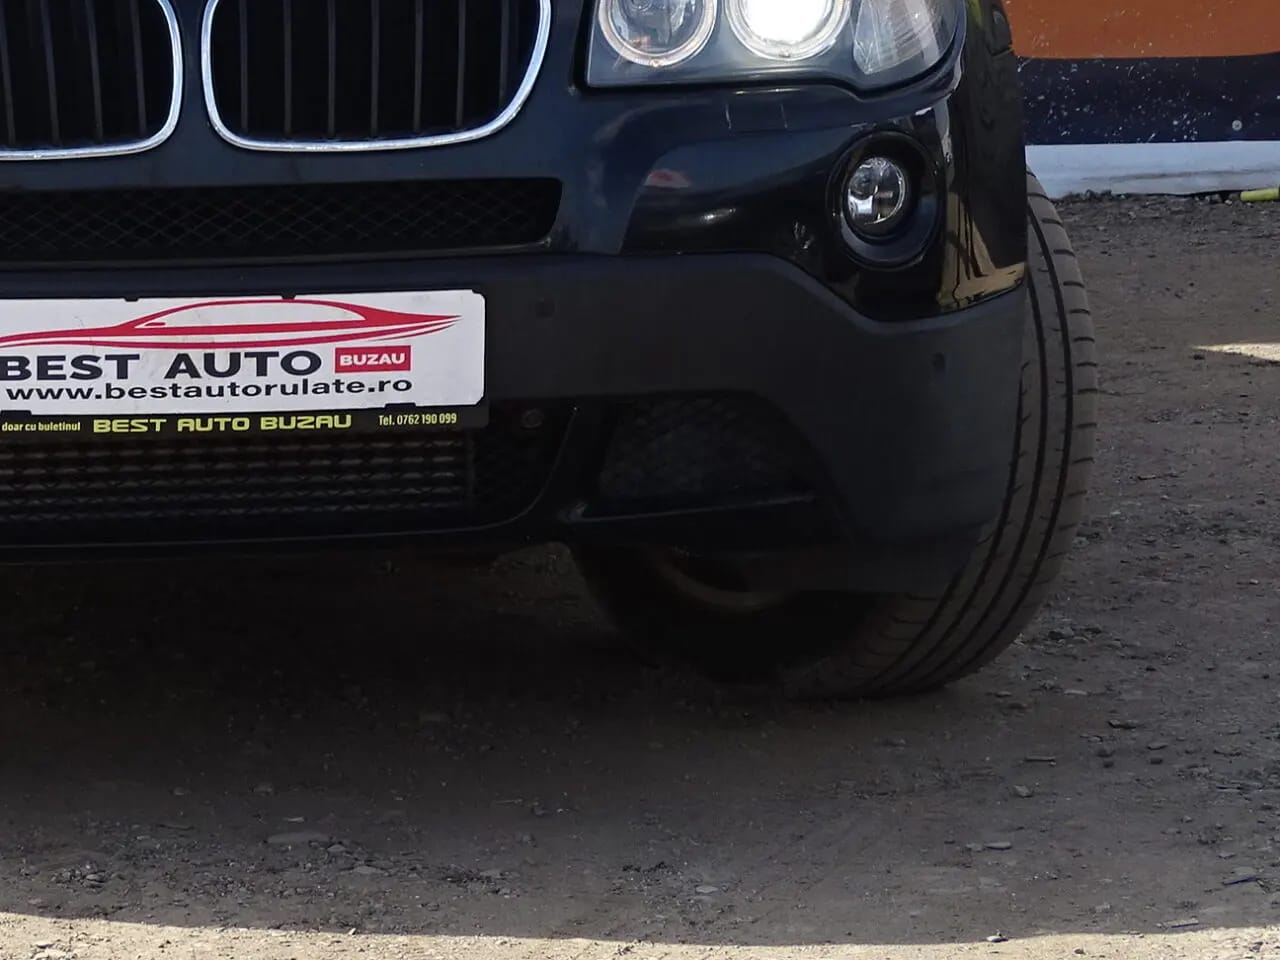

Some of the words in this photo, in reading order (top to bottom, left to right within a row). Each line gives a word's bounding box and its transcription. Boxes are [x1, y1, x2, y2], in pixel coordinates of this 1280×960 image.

[164, 350, 322, 379] AUTO
[338, 352, 406, 367] BUZAU
[6, 377, 413, 401] www.bestautorulate.ro
[1, 421, 24, 432] doar
[24, 422, 37, 431] cu
[38, 421, 81, 432] buletinul
[93, 418, 167, 433] BEST
[177, 416, 250, 432] AUTO
[260, 414, 352, 431] BUZAU
[378, 414, 396, 426] Tel.
[396, 413, 421, 425] 0762
[421, 413, 438, 425] 190
[439, 412, 458, 424] 099
